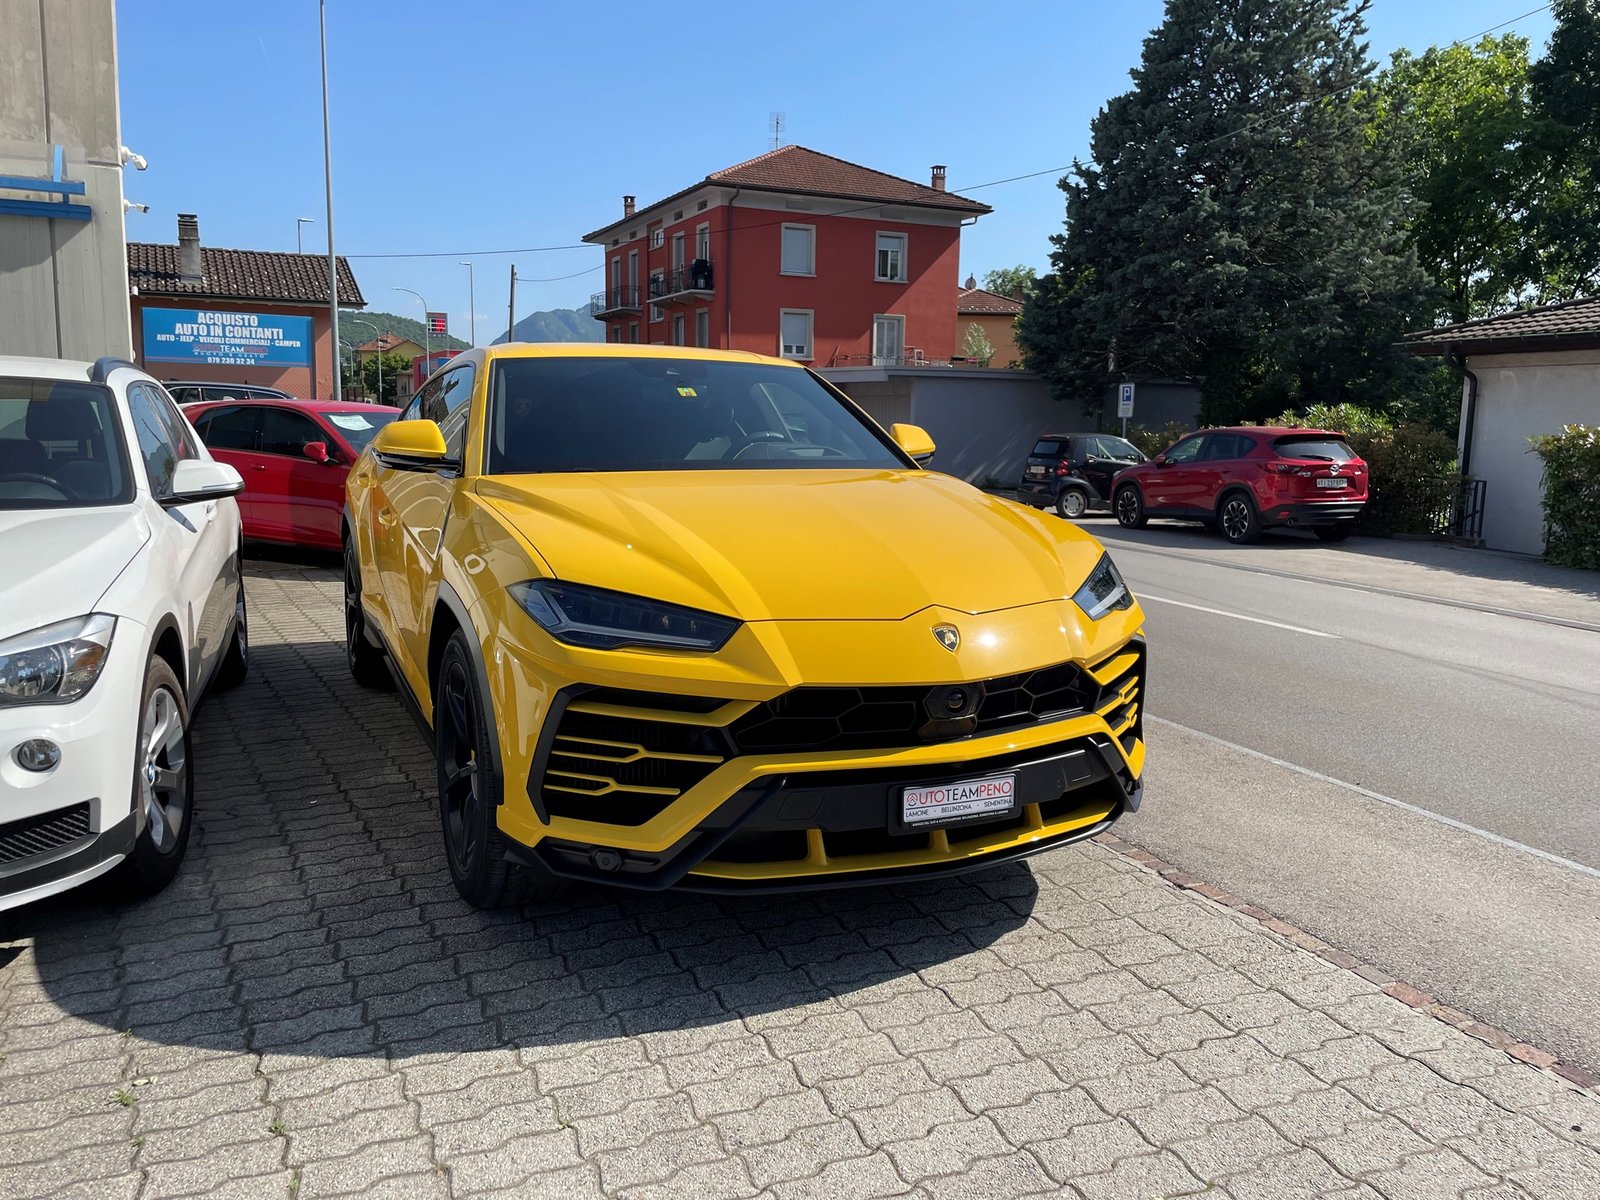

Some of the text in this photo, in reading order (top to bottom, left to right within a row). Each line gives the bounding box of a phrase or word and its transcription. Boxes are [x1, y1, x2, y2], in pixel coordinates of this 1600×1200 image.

[198, 312, 258, 326] ACQUISTO
[175, 323, 283, 339] AUTO IN CONTANTI
[156, 334, 175, 342] AUTO
[180, 335, 195, 343] JEEP
[199, 336, 225, 345] VEICOLI
[225, 337, 271, 346] COMMERCIALI
[274, 340, 302, 348] CAMPER
[1124, 388, 1130, 400] P
[906, 781, 1012, 807] AUTOTEAMPENO
[905, 798, 1013, 818] LAMONE BELLINZONA SEMENTINA
